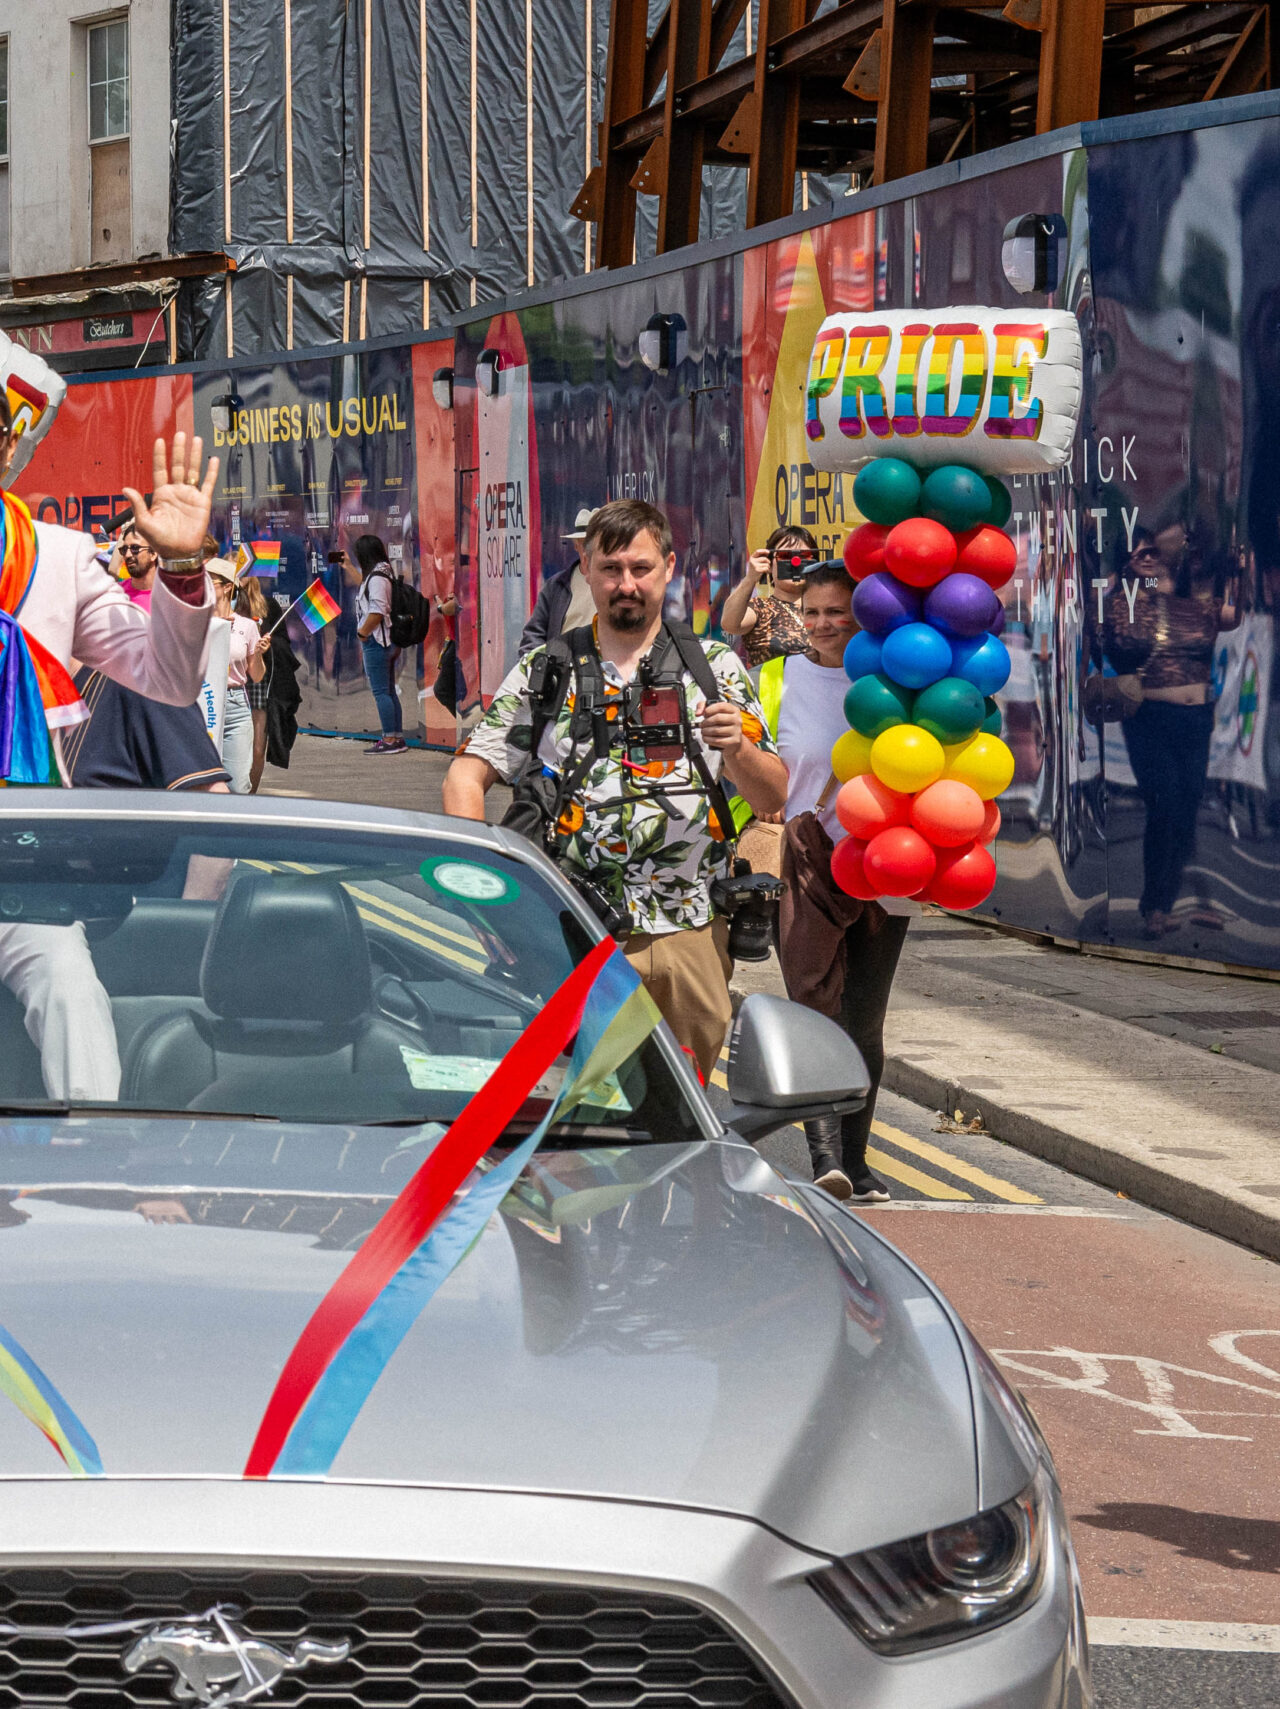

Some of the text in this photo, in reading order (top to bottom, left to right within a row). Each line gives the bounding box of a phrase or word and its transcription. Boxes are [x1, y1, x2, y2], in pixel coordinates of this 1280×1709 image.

[7, 325, 55, 352] NN
[806, 323, 1049, 442] PRIDE
[213, 393, 407, 447] BUSINESS AS USUAL
[1013, 434, 1138, 488] RICK
[485, 480, 527, 531] OPERA
[775, 463, 845, 528] OPERA
[1013, 506, 1139, 555] TWENTY
[486, 535, 522, 578] SQUARE
[1013, 578, 1140, 624] THIRTY
[204, 689, 217, 729] Health
